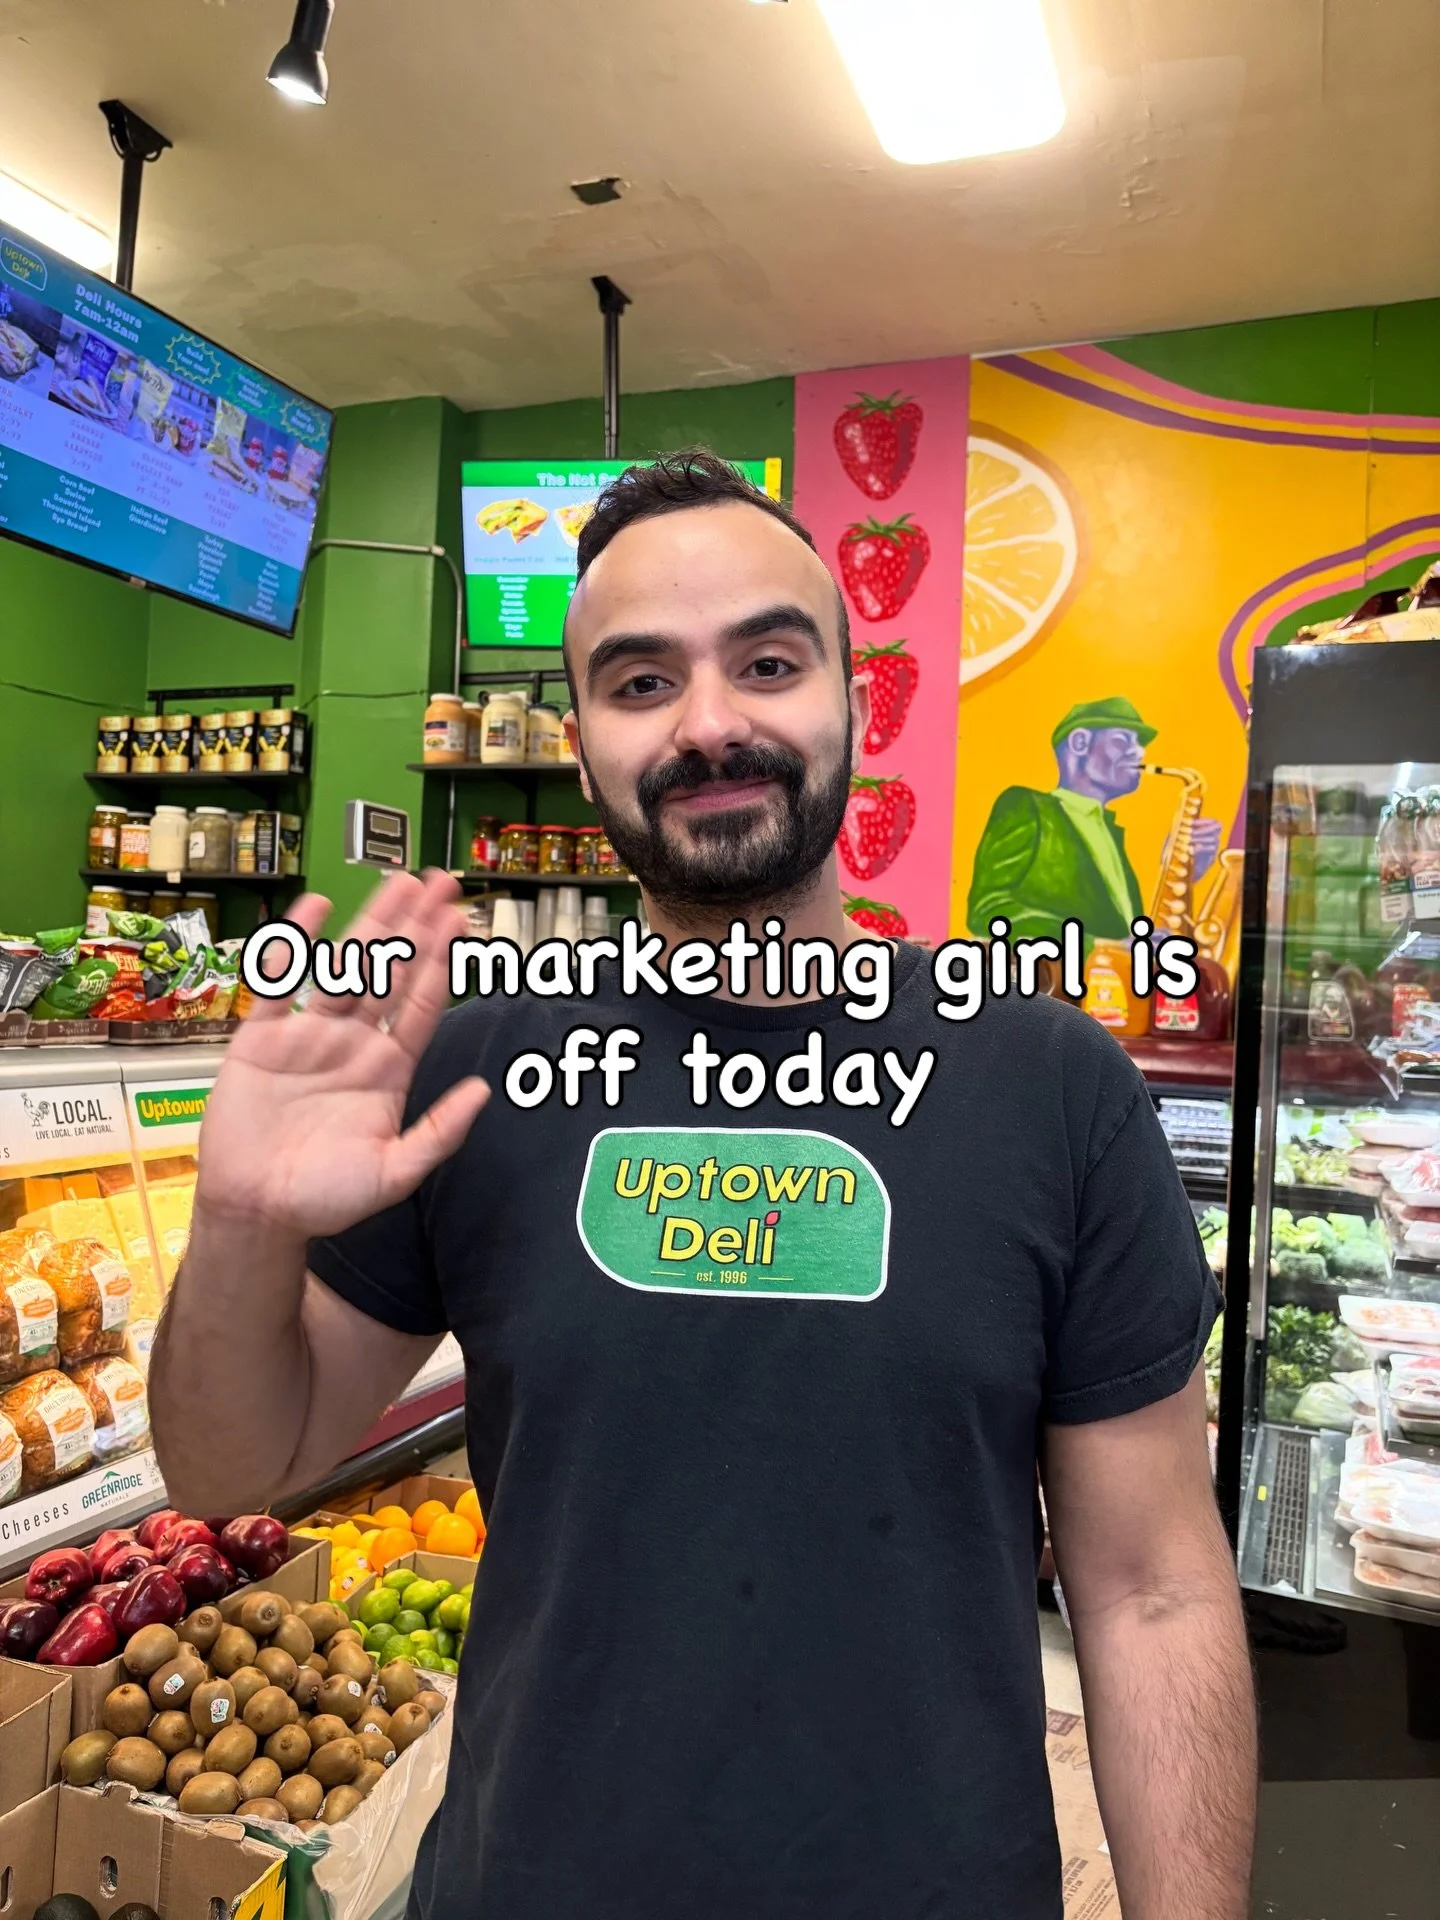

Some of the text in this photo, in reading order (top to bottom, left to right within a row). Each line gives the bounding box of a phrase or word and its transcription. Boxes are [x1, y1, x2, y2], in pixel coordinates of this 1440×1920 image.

[5, 246, 43, 273] Uptown
[74, 299, 139, 344] 7am-12am
[75, 283, 142, 329] Deli Hours
[536, 472, 566, 486] The
[52, 1098, 112, 1125] LOCAL.
[140, 1096, 206, 1122] Uptown
[36, 1125, 114, 1140] LIVE LOCAL. EAT NATURAL.
[615, 1156, 857, 1215] Uptown
[658, 1210, 781, 1266] Deli
[696, 1270, 748, 1284] est. 1996
[82, 1473, 143, 1509] GREENRIDGE
[1, 1503, 69, 1540] Cheeses
